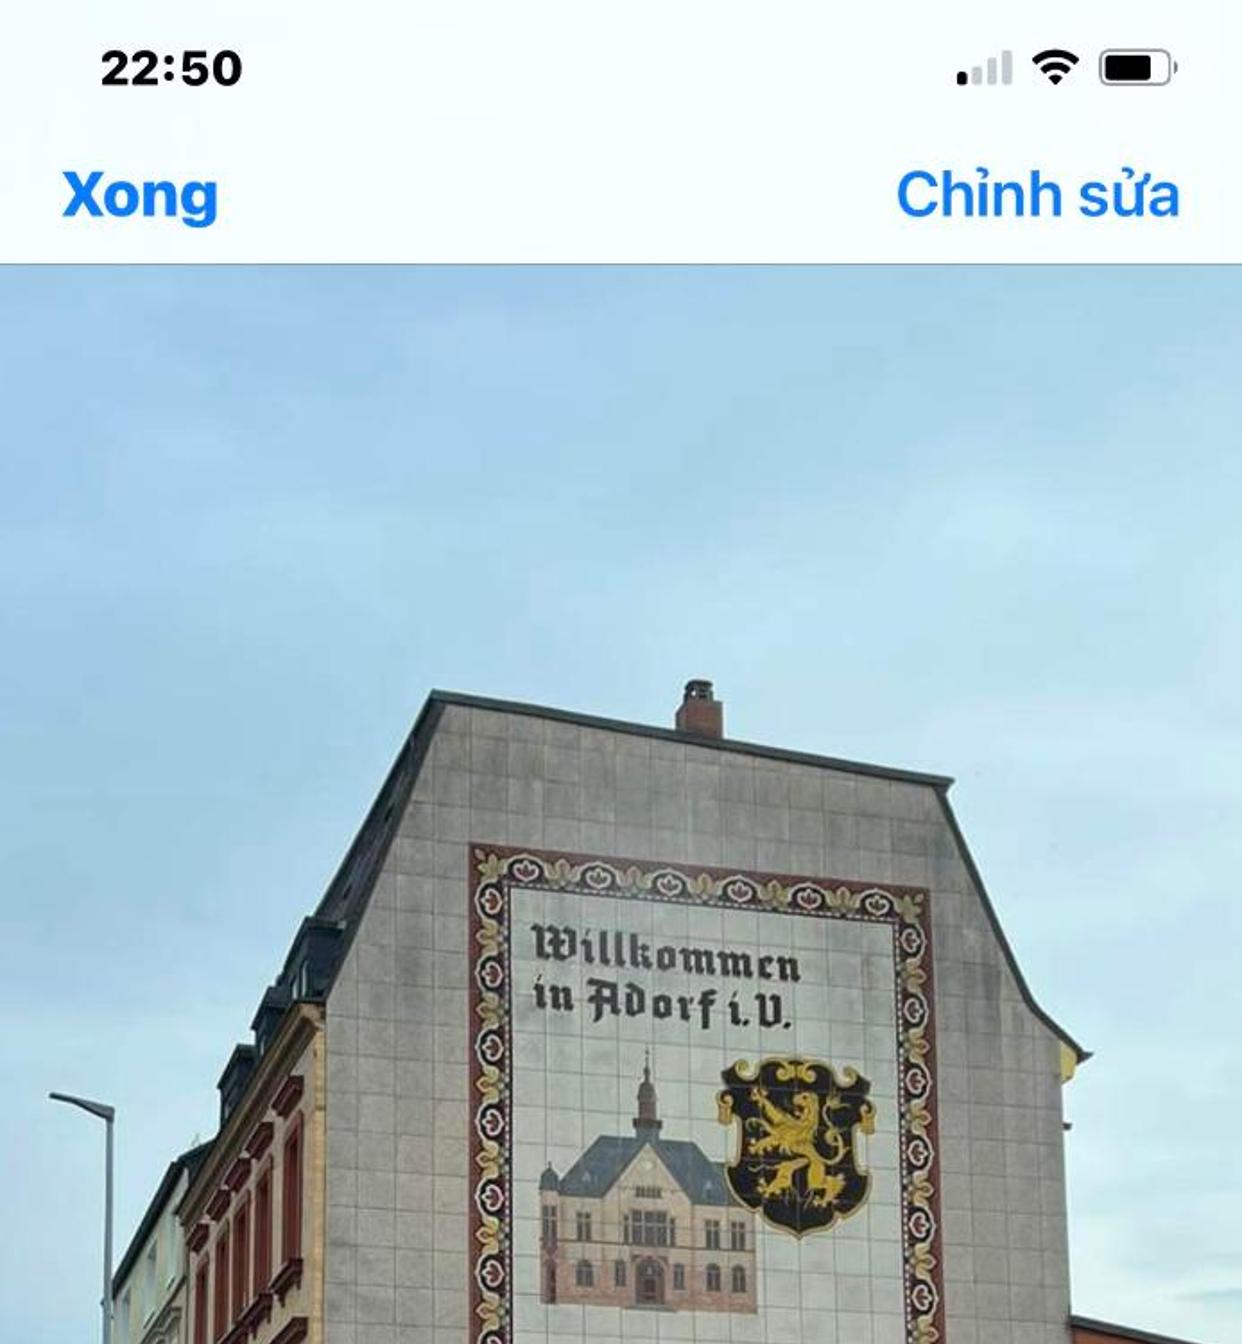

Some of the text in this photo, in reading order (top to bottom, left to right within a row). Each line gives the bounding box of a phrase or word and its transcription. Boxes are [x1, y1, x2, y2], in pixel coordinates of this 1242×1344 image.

[531, 924, 801, 983] Willkommen
[533, 975, 574, 1011] in
[586, 977, 718, 1030] Adorf
